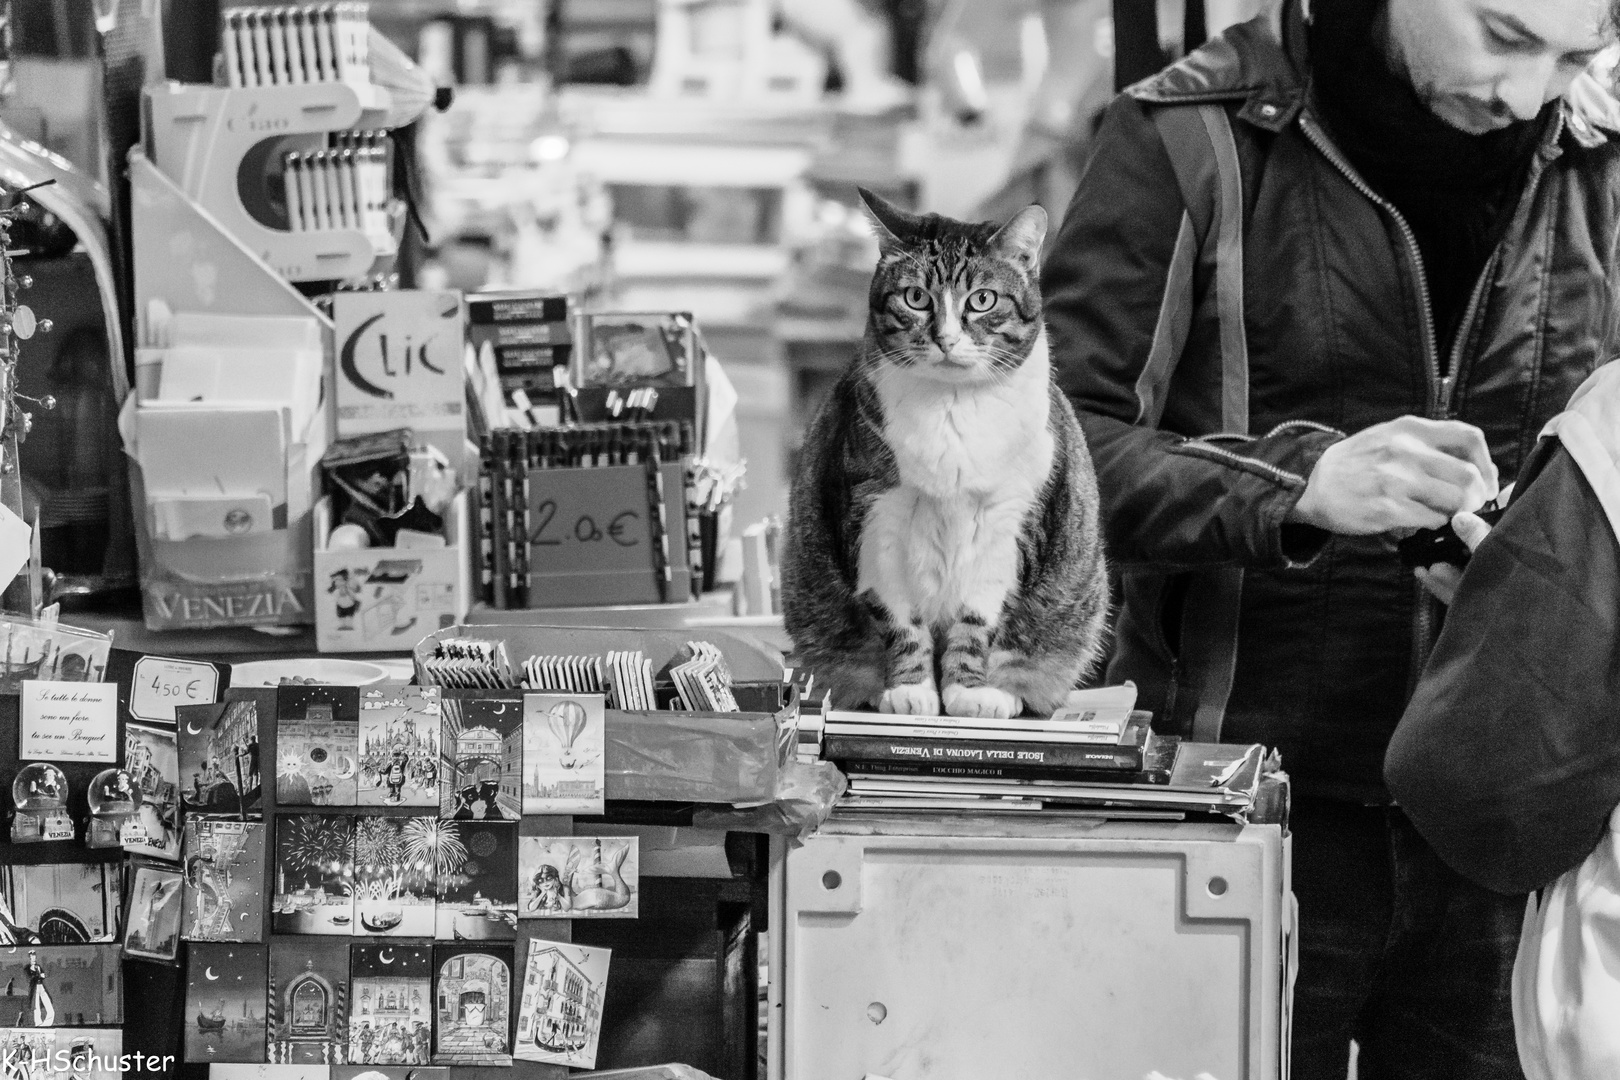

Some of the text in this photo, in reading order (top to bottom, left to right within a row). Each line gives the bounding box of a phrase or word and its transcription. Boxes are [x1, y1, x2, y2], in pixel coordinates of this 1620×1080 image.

[151, 588, 303, 620] VENEZIA
[50, 693, 69, 701] tutte
[79, 692, 103, 703] donne
[68, 729, 106, 745] Bouquet
[890, 745, 1044, 762] ISOLE DELLA LAGUNA DI VENEZIA
[932, 766, 966, 774] L'OCCHIO
[145, 837, 167, 850] ENEZIA
